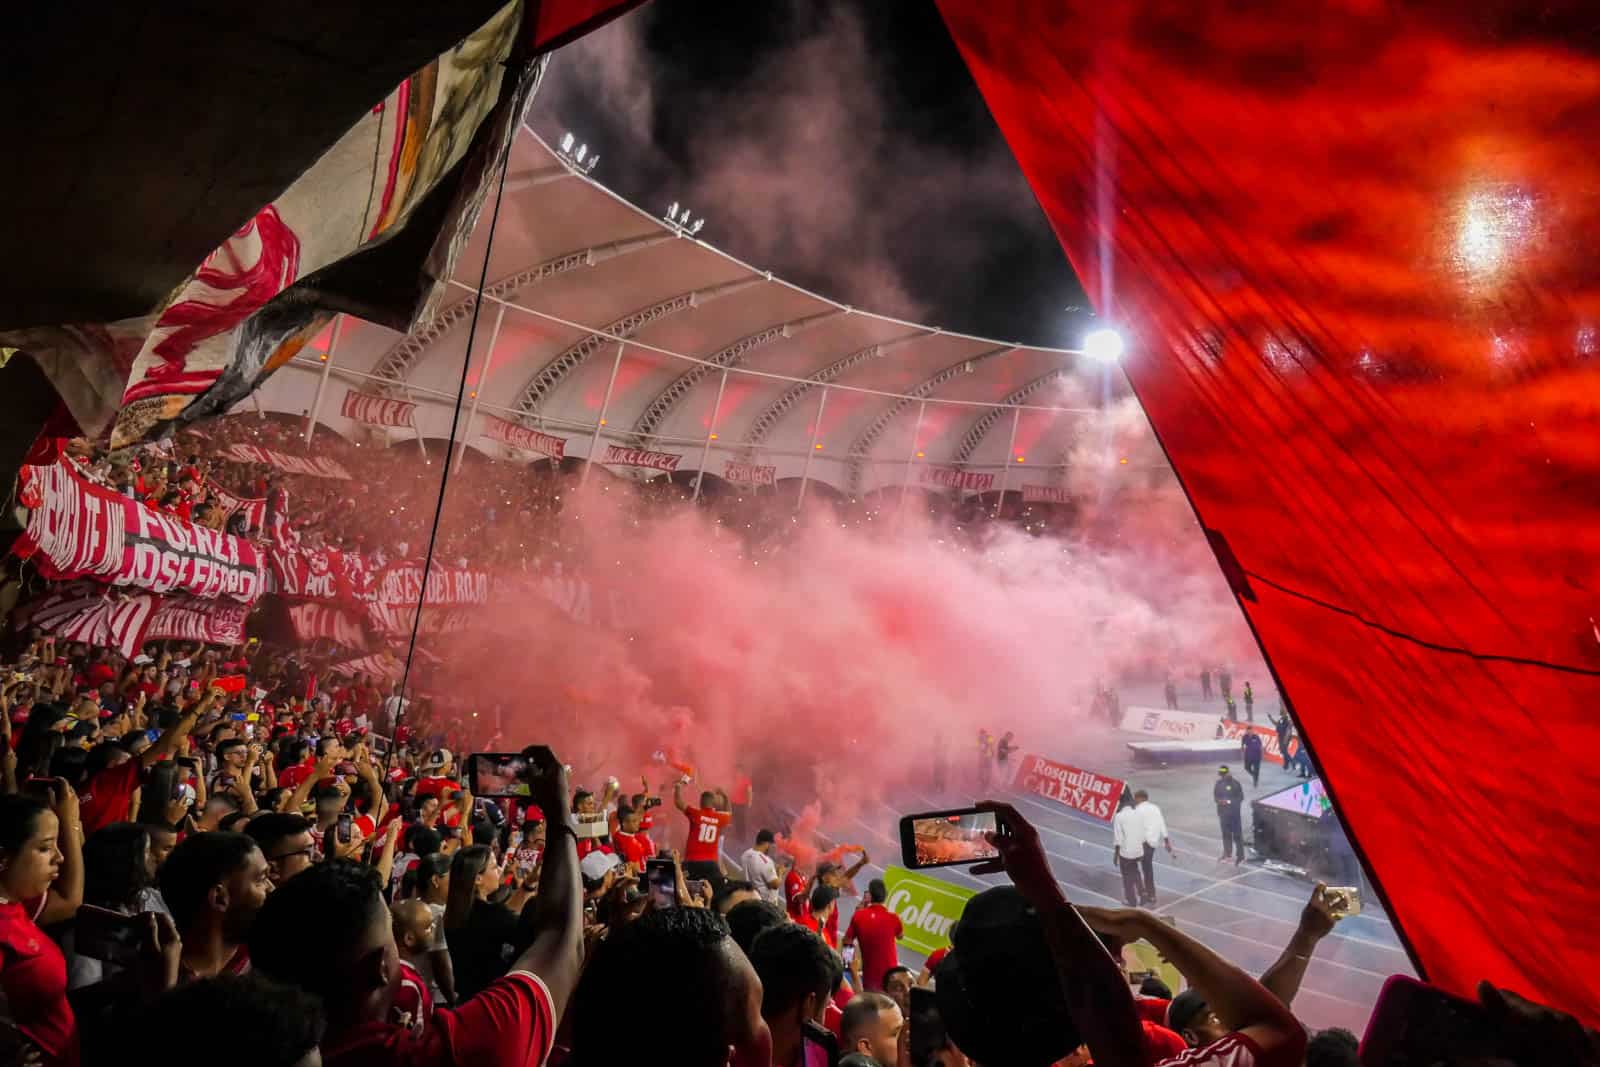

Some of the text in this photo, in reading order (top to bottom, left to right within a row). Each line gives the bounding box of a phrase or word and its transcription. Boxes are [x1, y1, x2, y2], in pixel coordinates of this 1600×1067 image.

[1032, 760, 1112, 796] Rosquillas
[1023, 775, 1111, 818] CALEÑAS
[698, 823, 718, 843] 10
